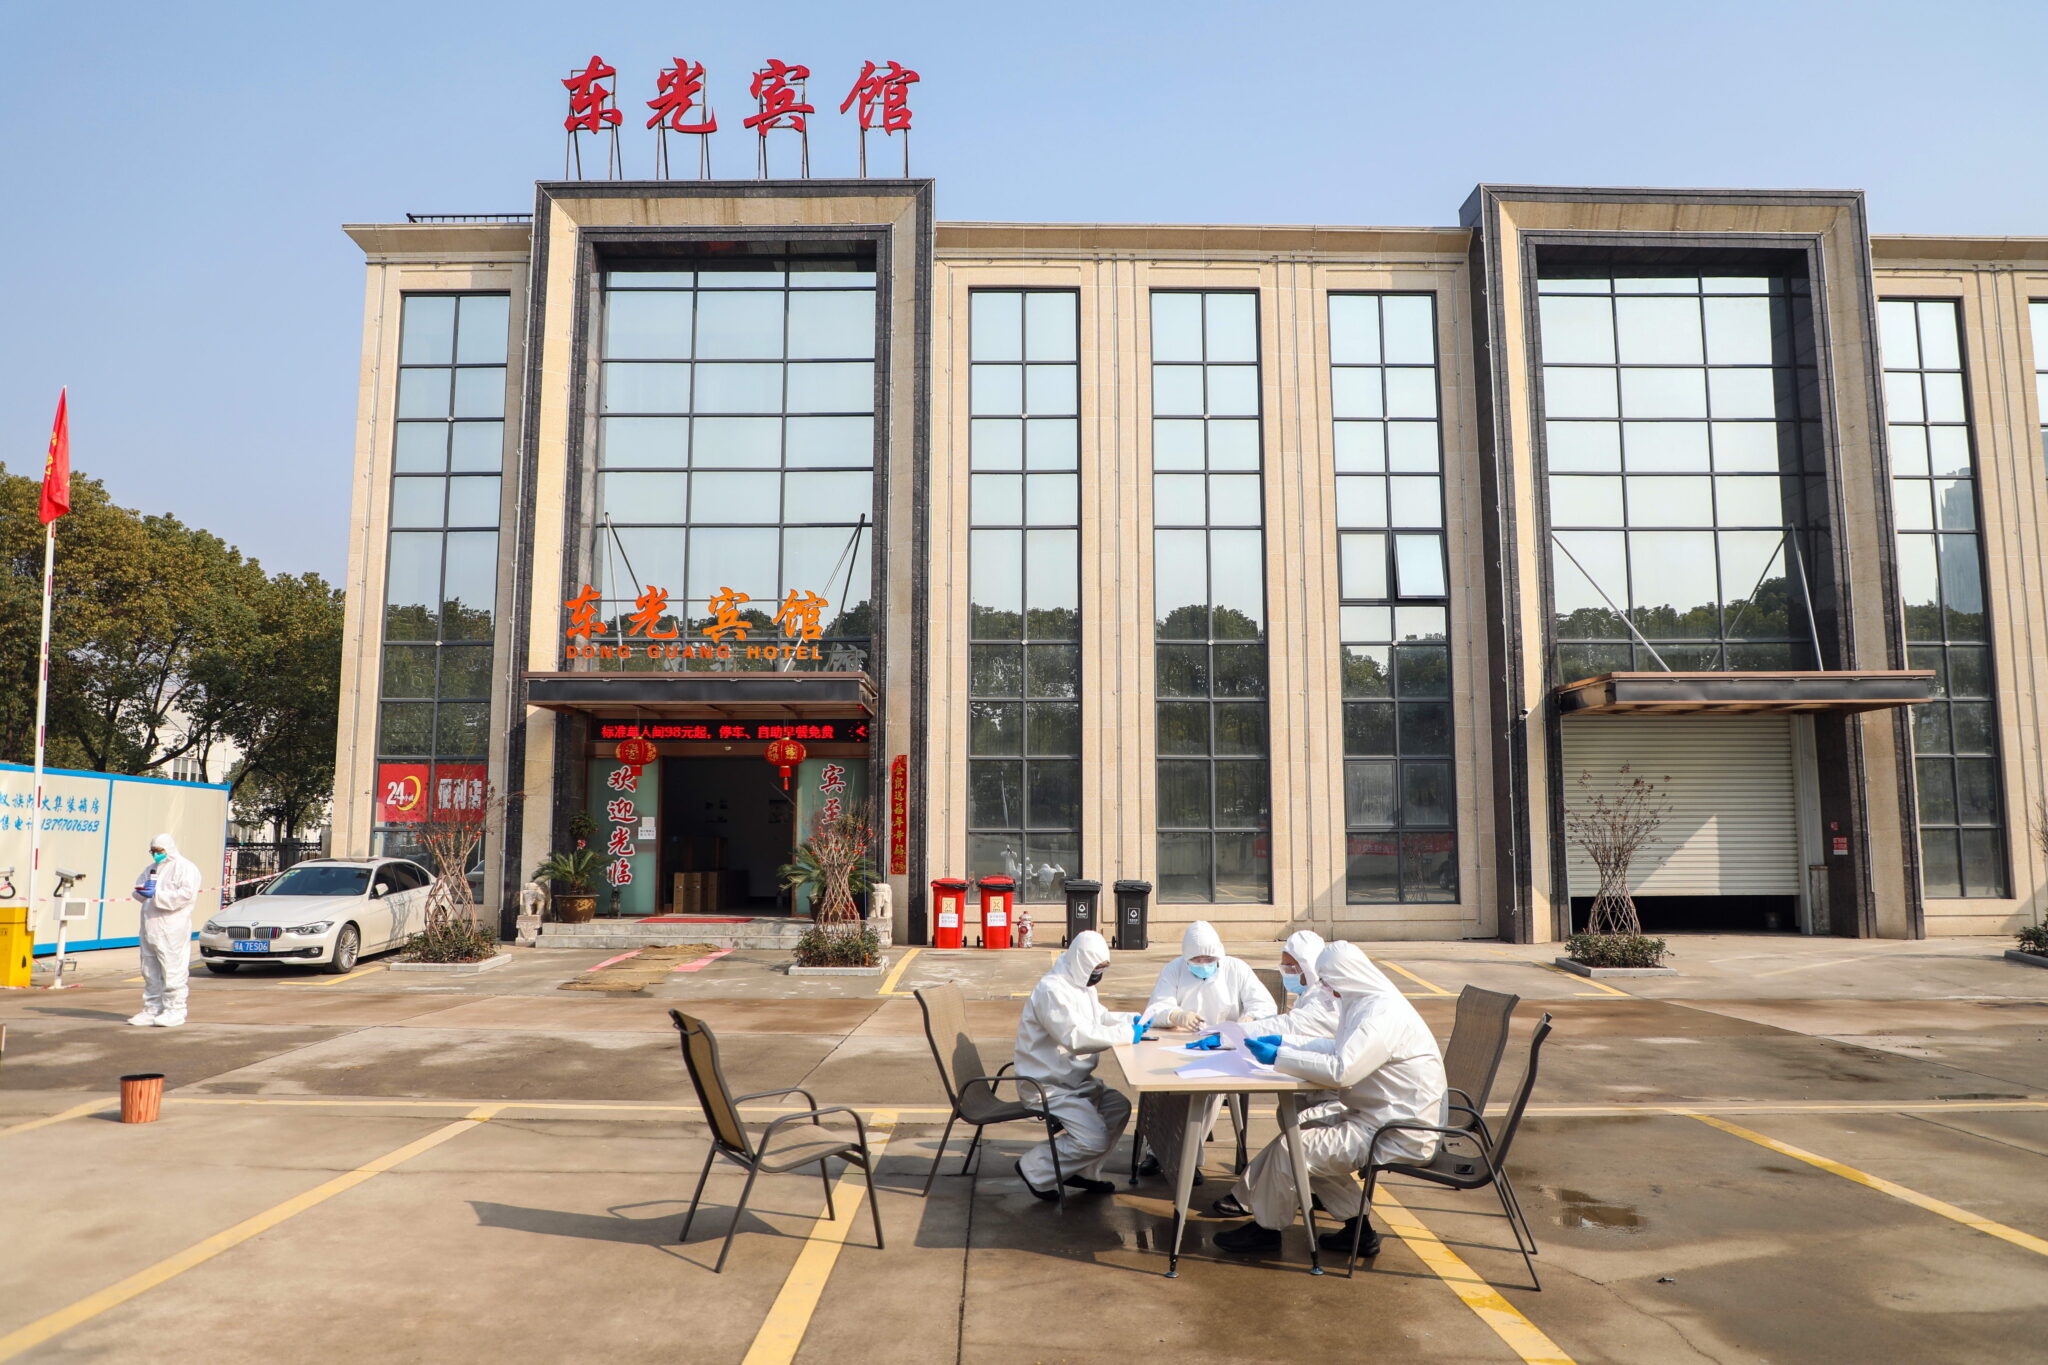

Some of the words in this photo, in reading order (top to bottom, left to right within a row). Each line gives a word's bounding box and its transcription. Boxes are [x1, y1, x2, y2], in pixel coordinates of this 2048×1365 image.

[561, 55, 920, 137] 东光宾馆
[565, 583, 828, 643] 东光宾馆
[566, 645, 631, 659] DONG
[647, 645, 730, 659] GUANG
[747, 646, 823, 660] HOTEL
[386, 781, 405, 805] 24
[438, 778, 482, 809] 便利店
[608, 766, 638, 886] 欢迎光临
